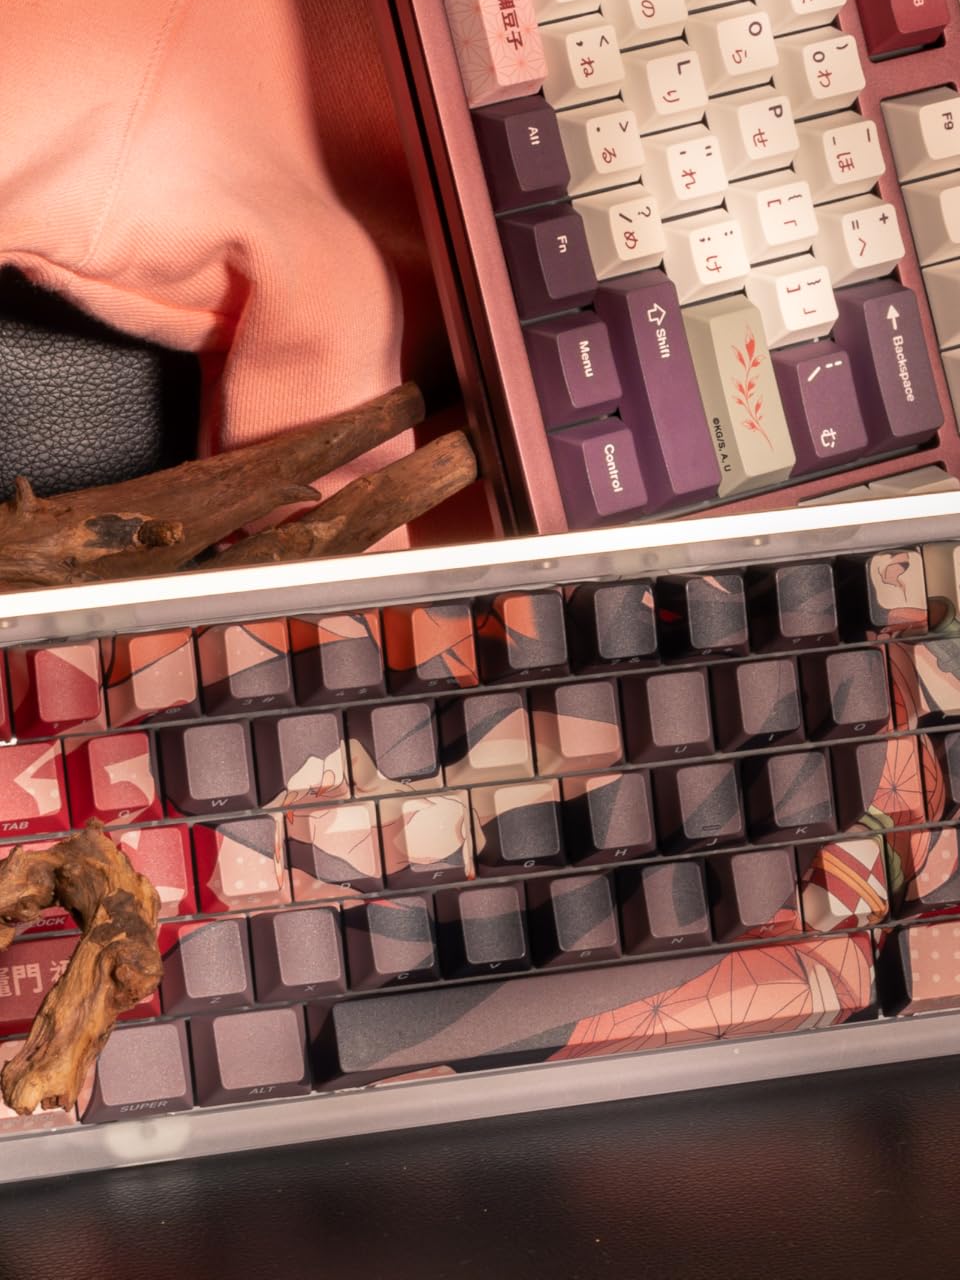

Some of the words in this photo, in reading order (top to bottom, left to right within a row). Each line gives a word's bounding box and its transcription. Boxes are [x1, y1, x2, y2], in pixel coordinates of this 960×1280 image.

[640, 0, 656, 19] の
[731, 48, 748, 65] ら
[579, 56, 596, 79] ね
[676, 59, 691, 76] L
[816, 69, 833, 89] わ
[661, 89, 681, 104] り
[767, 104, 784, 119] P
[941, 111, 955, 131] F9
[527, 126, 541, 146] Alt
[752, 127, 769, 148] せ
[601, 146, 617, 165] る
[835, 151, 856, 173] ほ
[680, 168, 697, 190] れ
[556, 234, 569, 254] Fn
[623, 230, 640, 250] め
[857, 237, 867, 257] へ
[705, 254, 723, 273] け
[655, 327, 671, 359] Shift
[578, 339, 595, 378] Menu
[891, 335, 915, 403] Backspace
[820, 428, 837, 449] む
[603, 443, 624, 493] Control
[853, 722, 867, 732] O
[210, 799, 229, 808] W
[1, 821, 30, 832] TAB
[794, 825, 809, 835] K
[705, 837, 719, 847] J
[614, 847, 629, 857] H
[523, 859, 537, 868] G
[431, 870, 444, 880] F
[670, 936, 685, 945] N
[489, 961, 503, 970] V
[303, 984, 317, 992] X
[210, 995, 222, 1004] Z
[248, 1086, 275, 1095] ALT
[119, 1099, 169, 1113] SUPER
